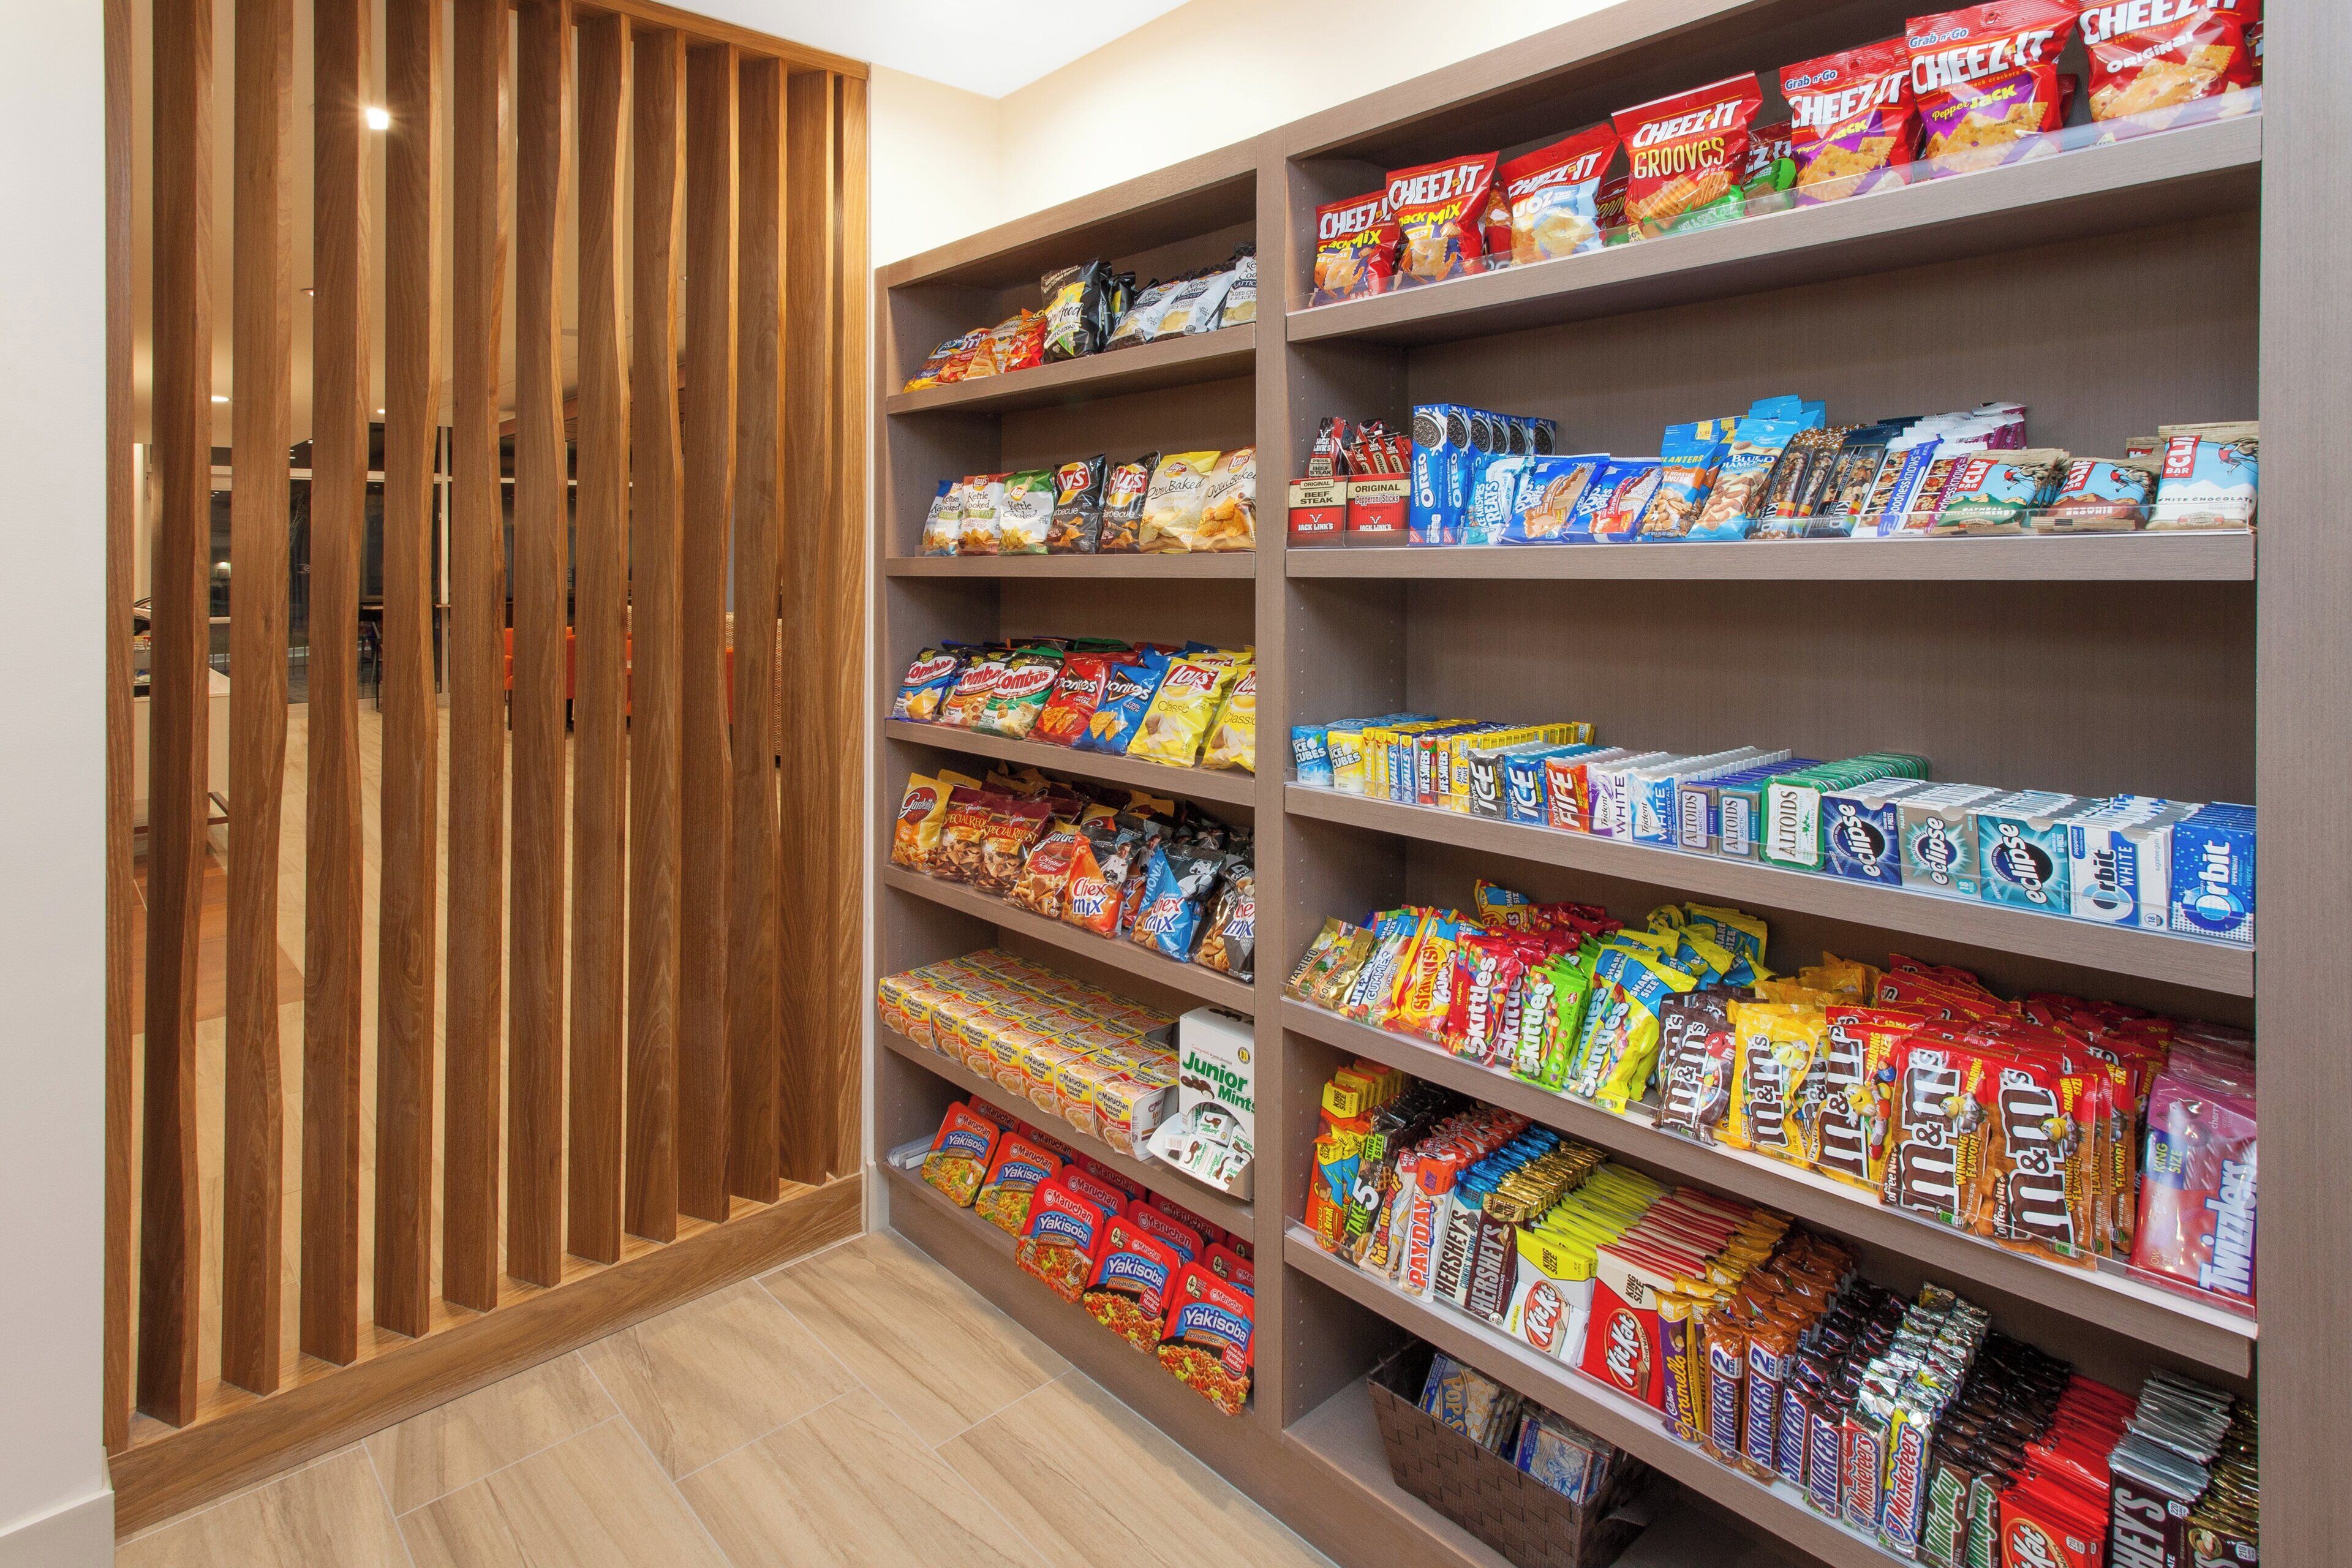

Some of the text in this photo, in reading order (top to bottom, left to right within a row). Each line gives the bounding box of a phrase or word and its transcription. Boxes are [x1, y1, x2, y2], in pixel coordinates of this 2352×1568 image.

[1909, 28, 1968, 48] Grab Go
[2115, 25, 2167, 43] baked snack
[1785, 69, 1838, 89] Grab Go
[1940, 71, 2021, 94] baked snack crackers
[1932, 102, 1970, 121] Pepper
[974, 477, 988, 488] Lay's
[1169, 476, 1205, 490] Baked
[1355, 484, 1400, 492] ORIGINAL
[1418, 453, 1435, 509] OREO
[1450, 453, 1463, 510] OREO
[2064, 483, 2081, 491] BAR
[966, 502, 990, 510] Cooked
[967, 491, 989, 502] Kettle
[1008, 500, 1033, 511] Kettle
[1355, 494, 1399, 505] Pepperoni Sticks
[1476, 483, 1485, 516] KRISPIES
[1607, 481, 1626, 515] Strawberry
[1003, 511, 1038, 519] Cooked
[907, 659, 952, 678] Combos
[996, 669, 1050, 689] Combos
[1168, 665, 1219, 690] Lay's
[1122, 703, 1139, 714] RANCH
[1129, 701, 1142, 709] COOL
[1158, 701, 1189, 714] Classic
[1294, 741, 1308, 752] ICE
[1296, 748, 1327, 764] CUBES
[1329, 745, 1344, 760] ICE
[1332, 752, 1362, 769] CUBES
[1471, 761, 1498, 812] ICE
[1509, 766, 1539, 818] ICE
[1509, 789, 1520, 820] Dentyne
[1616, 775, 1626, 834] WHITE
[1656, 786, 1666, 842] WHITE
[945, 814, 970, 825] SPECIAL
[1686, 794, 1697, 843] ALTOIDS
[1725, 799, 1738, 851] ALTOIDS
[1779, 790, 1798, 858] ALTOIDS
[983, 824, 1013, 837] SPECIAL
[1013, 827, 1039, 844] REQUEST
[1839, 804, 1881, 877] eclipse
[1039, 856, 1066, 867] Original
[1926, 816, 1950, 886] eclipse
[1039, 861, 1058, 872] Recipe
[1999, 823, 2048, 905] eclipse
[2119, 846, 2133, 887] WHITE
[1072, 877, 1108, 897] Chex
[1073, 897, 1106, 917] mix
[1144, 913, 1179, 935] mix
[1380, 917, 1393, 941] SHARE
[1387, 921, 1398, 936] SIZE
[1367, 951, 1393, 1000] GUMMIES
[1385, 963, 1398, 987] FLAVORS
[1629, 970, 1654, 998] SHARE
[1642, 979, 1660, 999] SIZE
[1464, 957, 1497, 1057] Skittles
[1519, 982, 1555, 1077] Skittles
[1866, 1032, 1882, 1072] SHARING
[1880, 1033, 1893, 1058] SIZE
[1028, 1055, 1052, 1072] Maruchan
[1029, 1064, 1046, 1075] Instant
[1031, 1069, 1045, 1080] Lunch
[1182, 1050, 1248, 1092] Junior
[1102, 1092, 1129, 1112] Maruchan
[1103, 1102, 1122, 1115] Instant
[1106, 1107, 1120, 1120] Lunch
[962, 1115, 991, 1138] Maruchan
[948, 1134, 986, 1154] Yakisoba
[1955, 1134, 1970, 1186] WINNING
[1967, 1134, 1982, 1179] FLAVOR!
[2153, 1142, 2169, 1174] KING
[2170, 1149, 2184, 1174] SIZE
[1054, 1191, 1092, 1224] Maruchan
[1346, 1177, 1379, 1237] TAKE 5
[1992, 1182, 2010, 1239] Coffee Nut
[1039, 1216, 1088, 1243] Yakisoba
[1406, 1194, 1432, 1289] PAYDAY
[1138, 1242, 1161, 1262] Maruchan
[1434, 1210, 1468, 1299] HERSHEY'S
[1542, 1247, 1551, 1272] KING
[1107, 1256, 1164, 1287] Yakisoba
[1459, 1264, 1470, 1289] COOKIES
[1471, 1224, 1504, 1316] HERSHEY'S
[1625, 1273, 1634, 1298] KING
[1633, 1278, 1643, 1304] SIZE
[1217, 1291, 1243, 1312] Maruchan
[1185, 1309, 1247, 1343] Yakisoba
[1188, 1332, 1219, 1346] Teriyaki Beef
[1667, 1354, 1694, 1441] Caramello
[1747, 1374, 1774, 1468] SNICKERS
[1887, 1425, 1919, 1539] 3 Musketeers
[2170, 1502, 2180, 1517] 220
